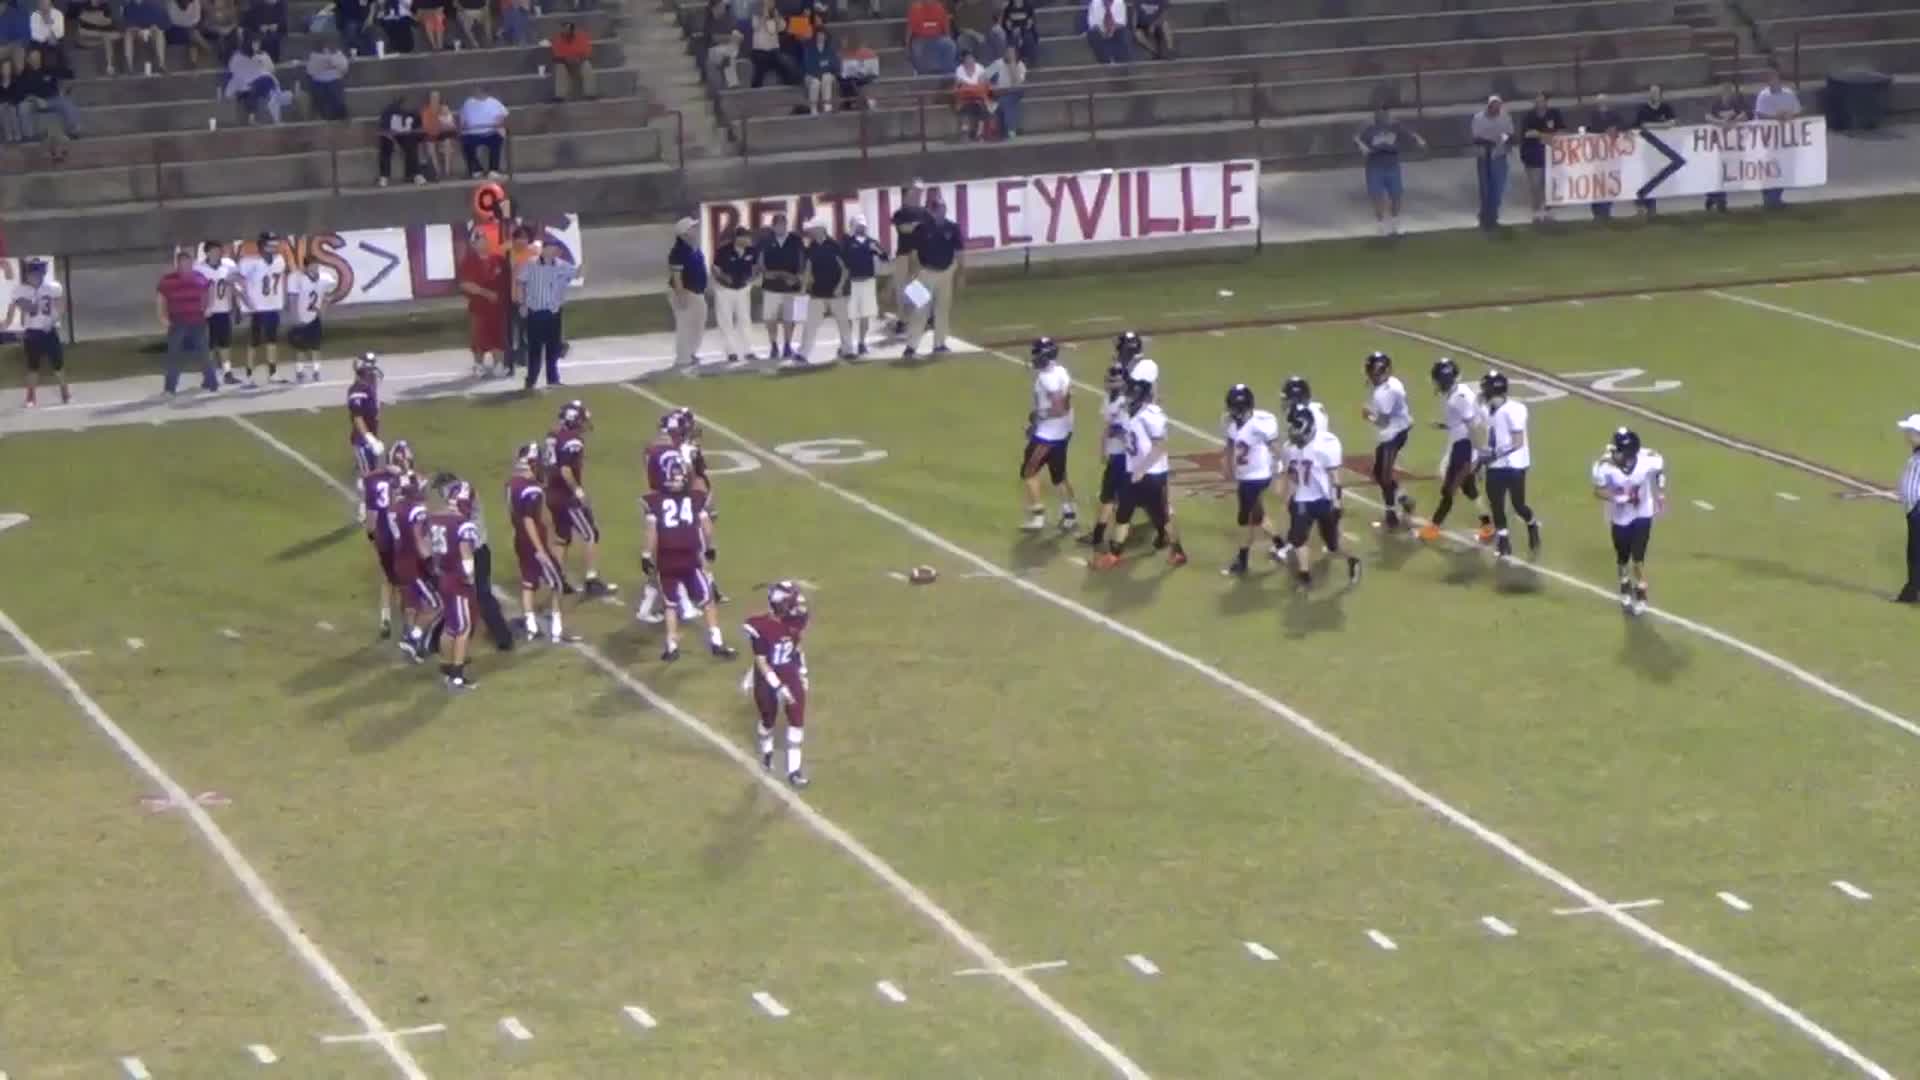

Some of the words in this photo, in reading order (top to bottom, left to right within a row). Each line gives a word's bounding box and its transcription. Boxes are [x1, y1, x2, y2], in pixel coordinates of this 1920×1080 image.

[1551, 130, 1635, 165] BROOKS
[1551, 170, 1622, 202] LIONS
[1722, 159, 1782, 182] LIONS
[662, 497, 694, 528] 24
[773, 640, 794, 665] 12
